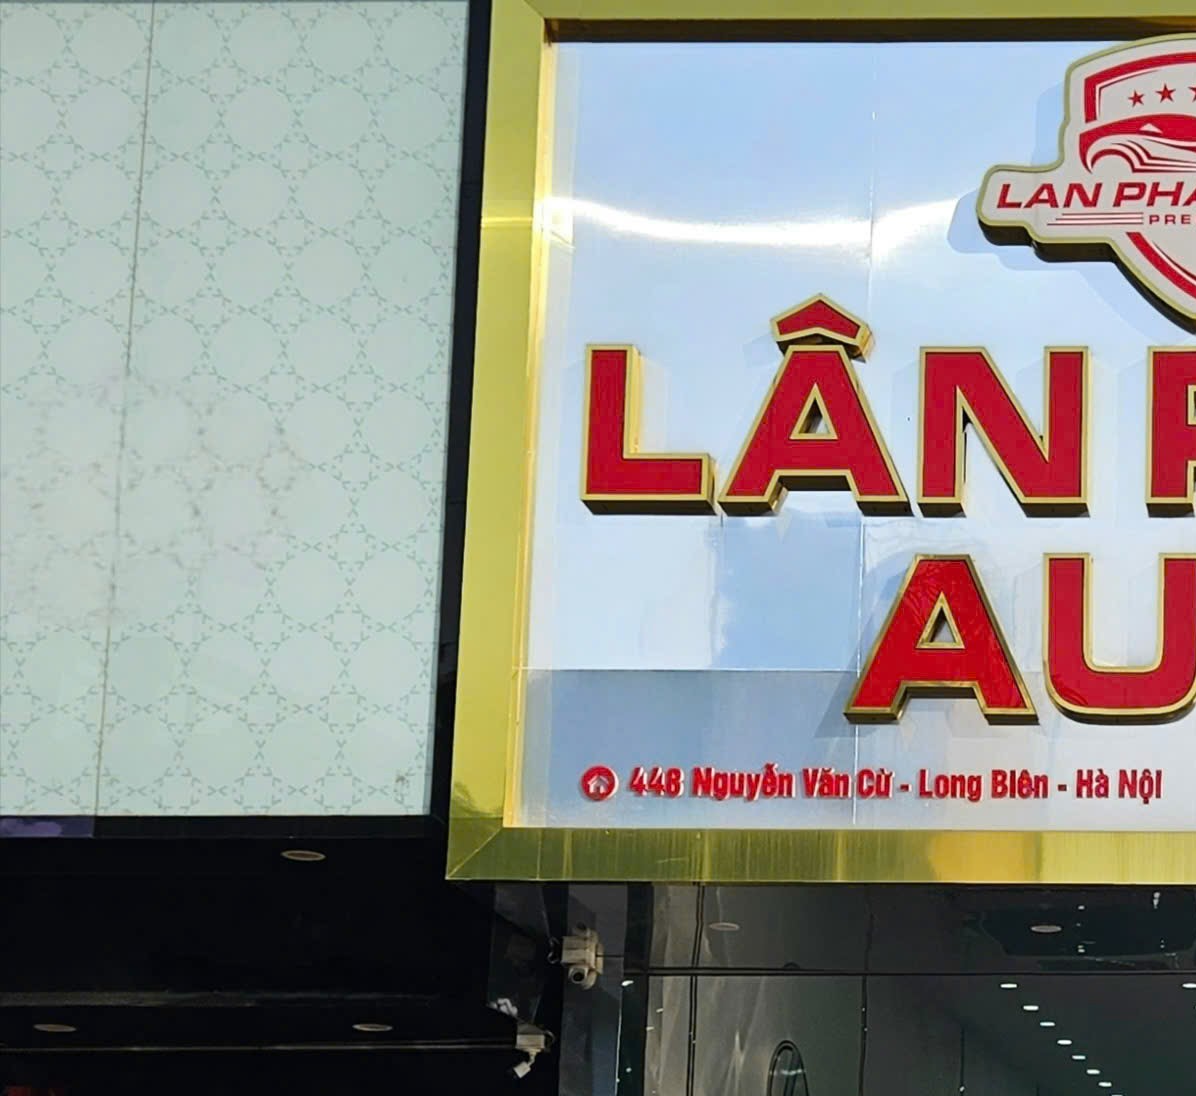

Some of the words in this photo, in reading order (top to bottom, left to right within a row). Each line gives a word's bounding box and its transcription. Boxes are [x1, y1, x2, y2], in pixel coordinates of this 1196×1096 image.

[996, 182, 1103, 209] LAN
[580, 293, 1090, 515] LÂN
[692, 763, 796, 801] Nguyễn
[802, 767, 852, 798] Văn
[857, 767, 894, 799] Cừ
[918, 769, 983, 802] Long
[1076, 768, 1110, 798] Hà
